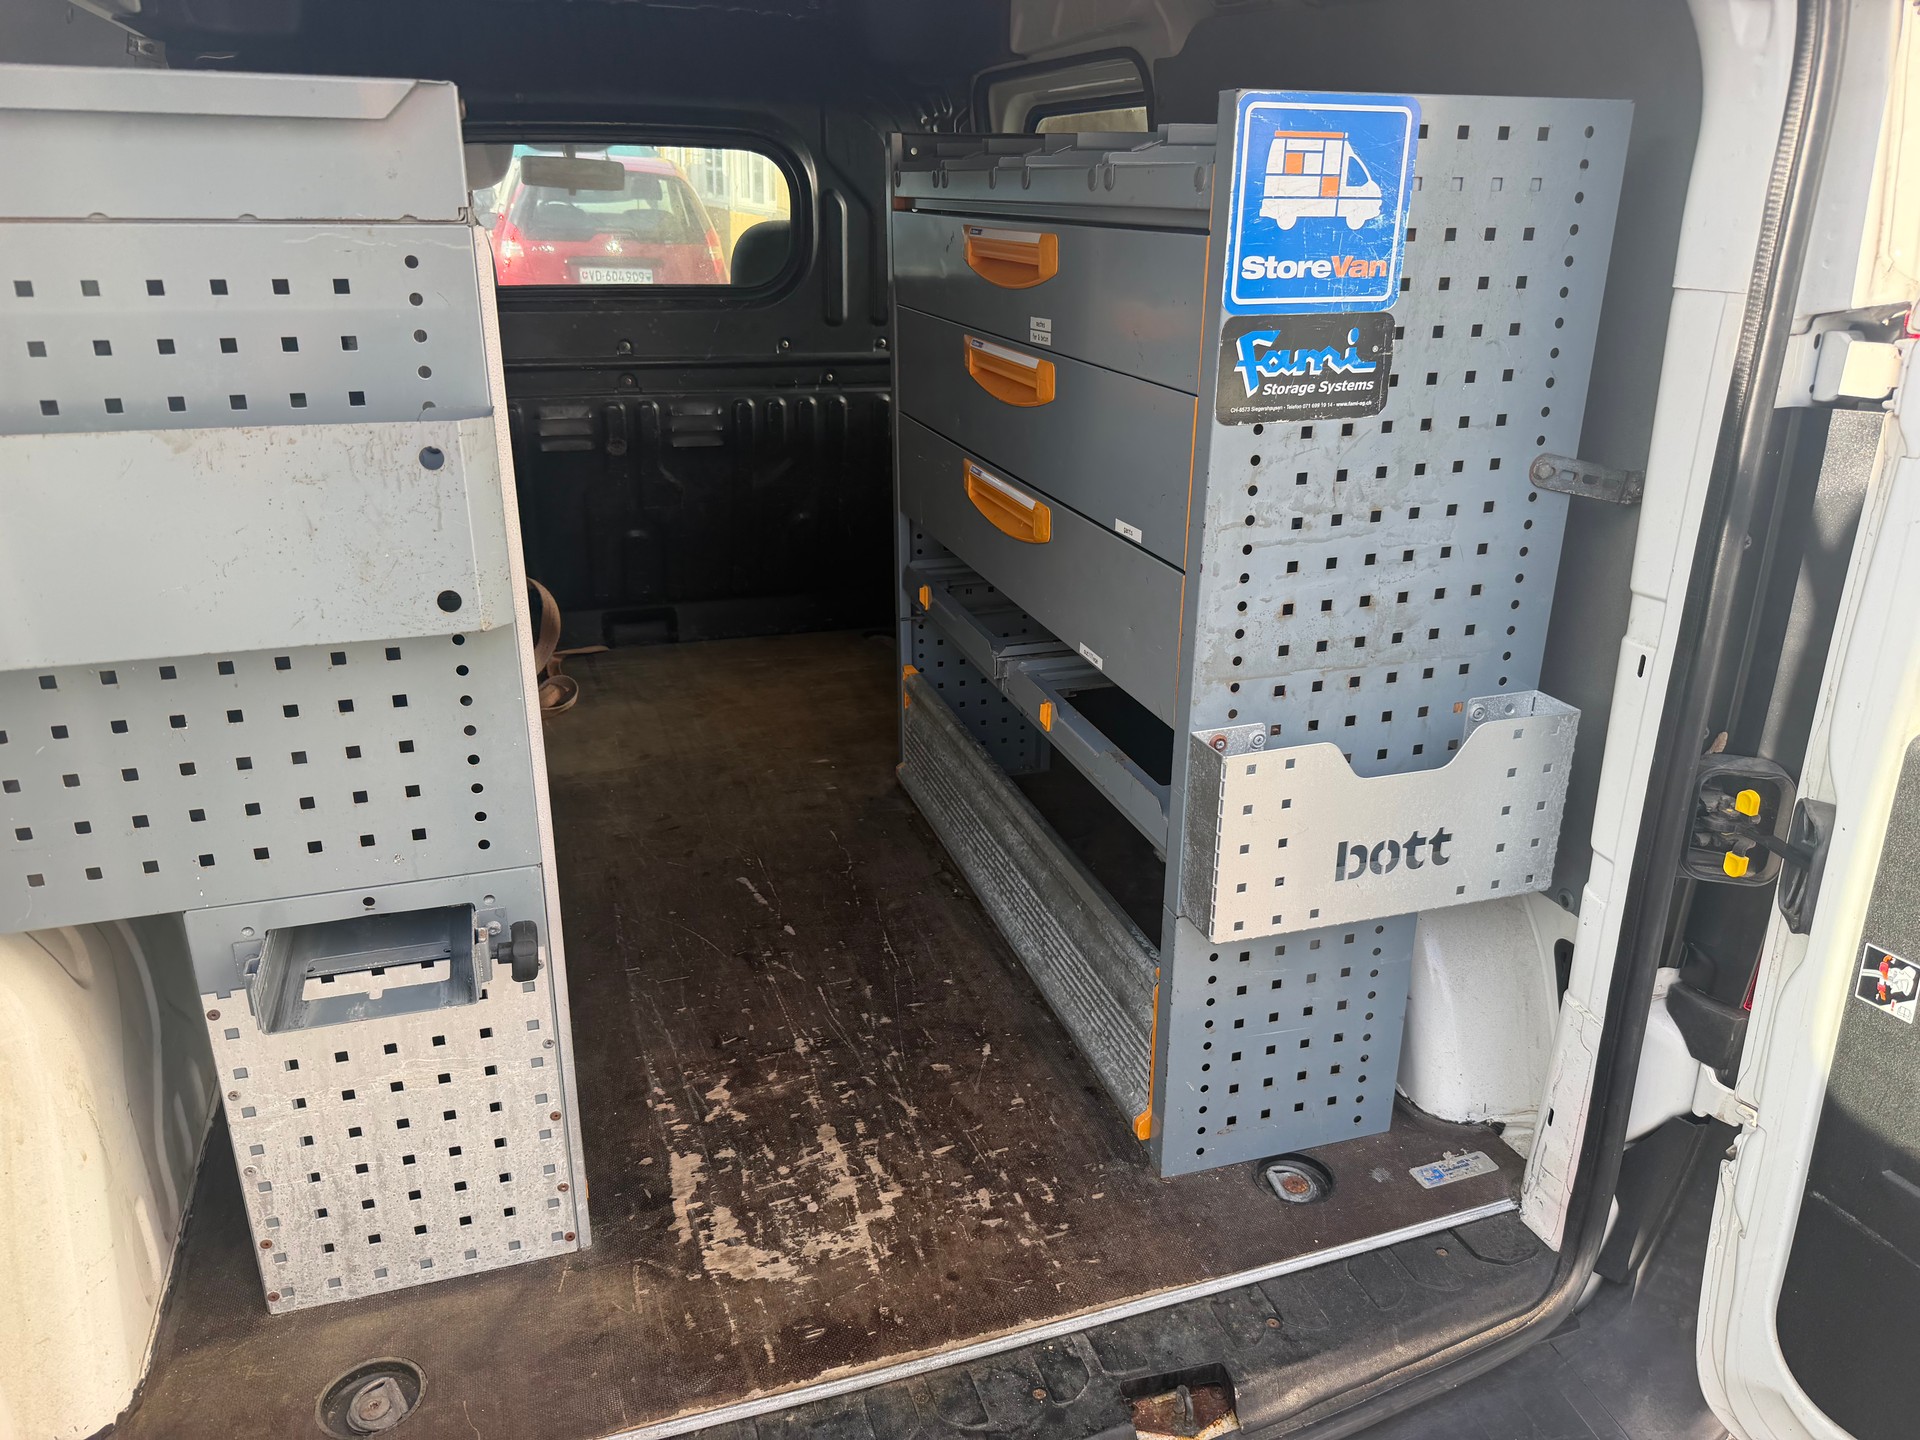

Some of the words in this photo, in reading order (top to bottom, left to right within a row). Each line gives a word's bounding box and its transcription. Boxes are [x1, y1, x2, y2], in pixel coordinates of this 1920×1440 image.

[1241, 255, 1388, 280] StoreVan
[1234, 327, 1377, 398] Fami
[1262, 382, 1316, 397] Storage
[1318, 380, 1374, 394] Systems
[1335, 827, 1453, 881] bott
